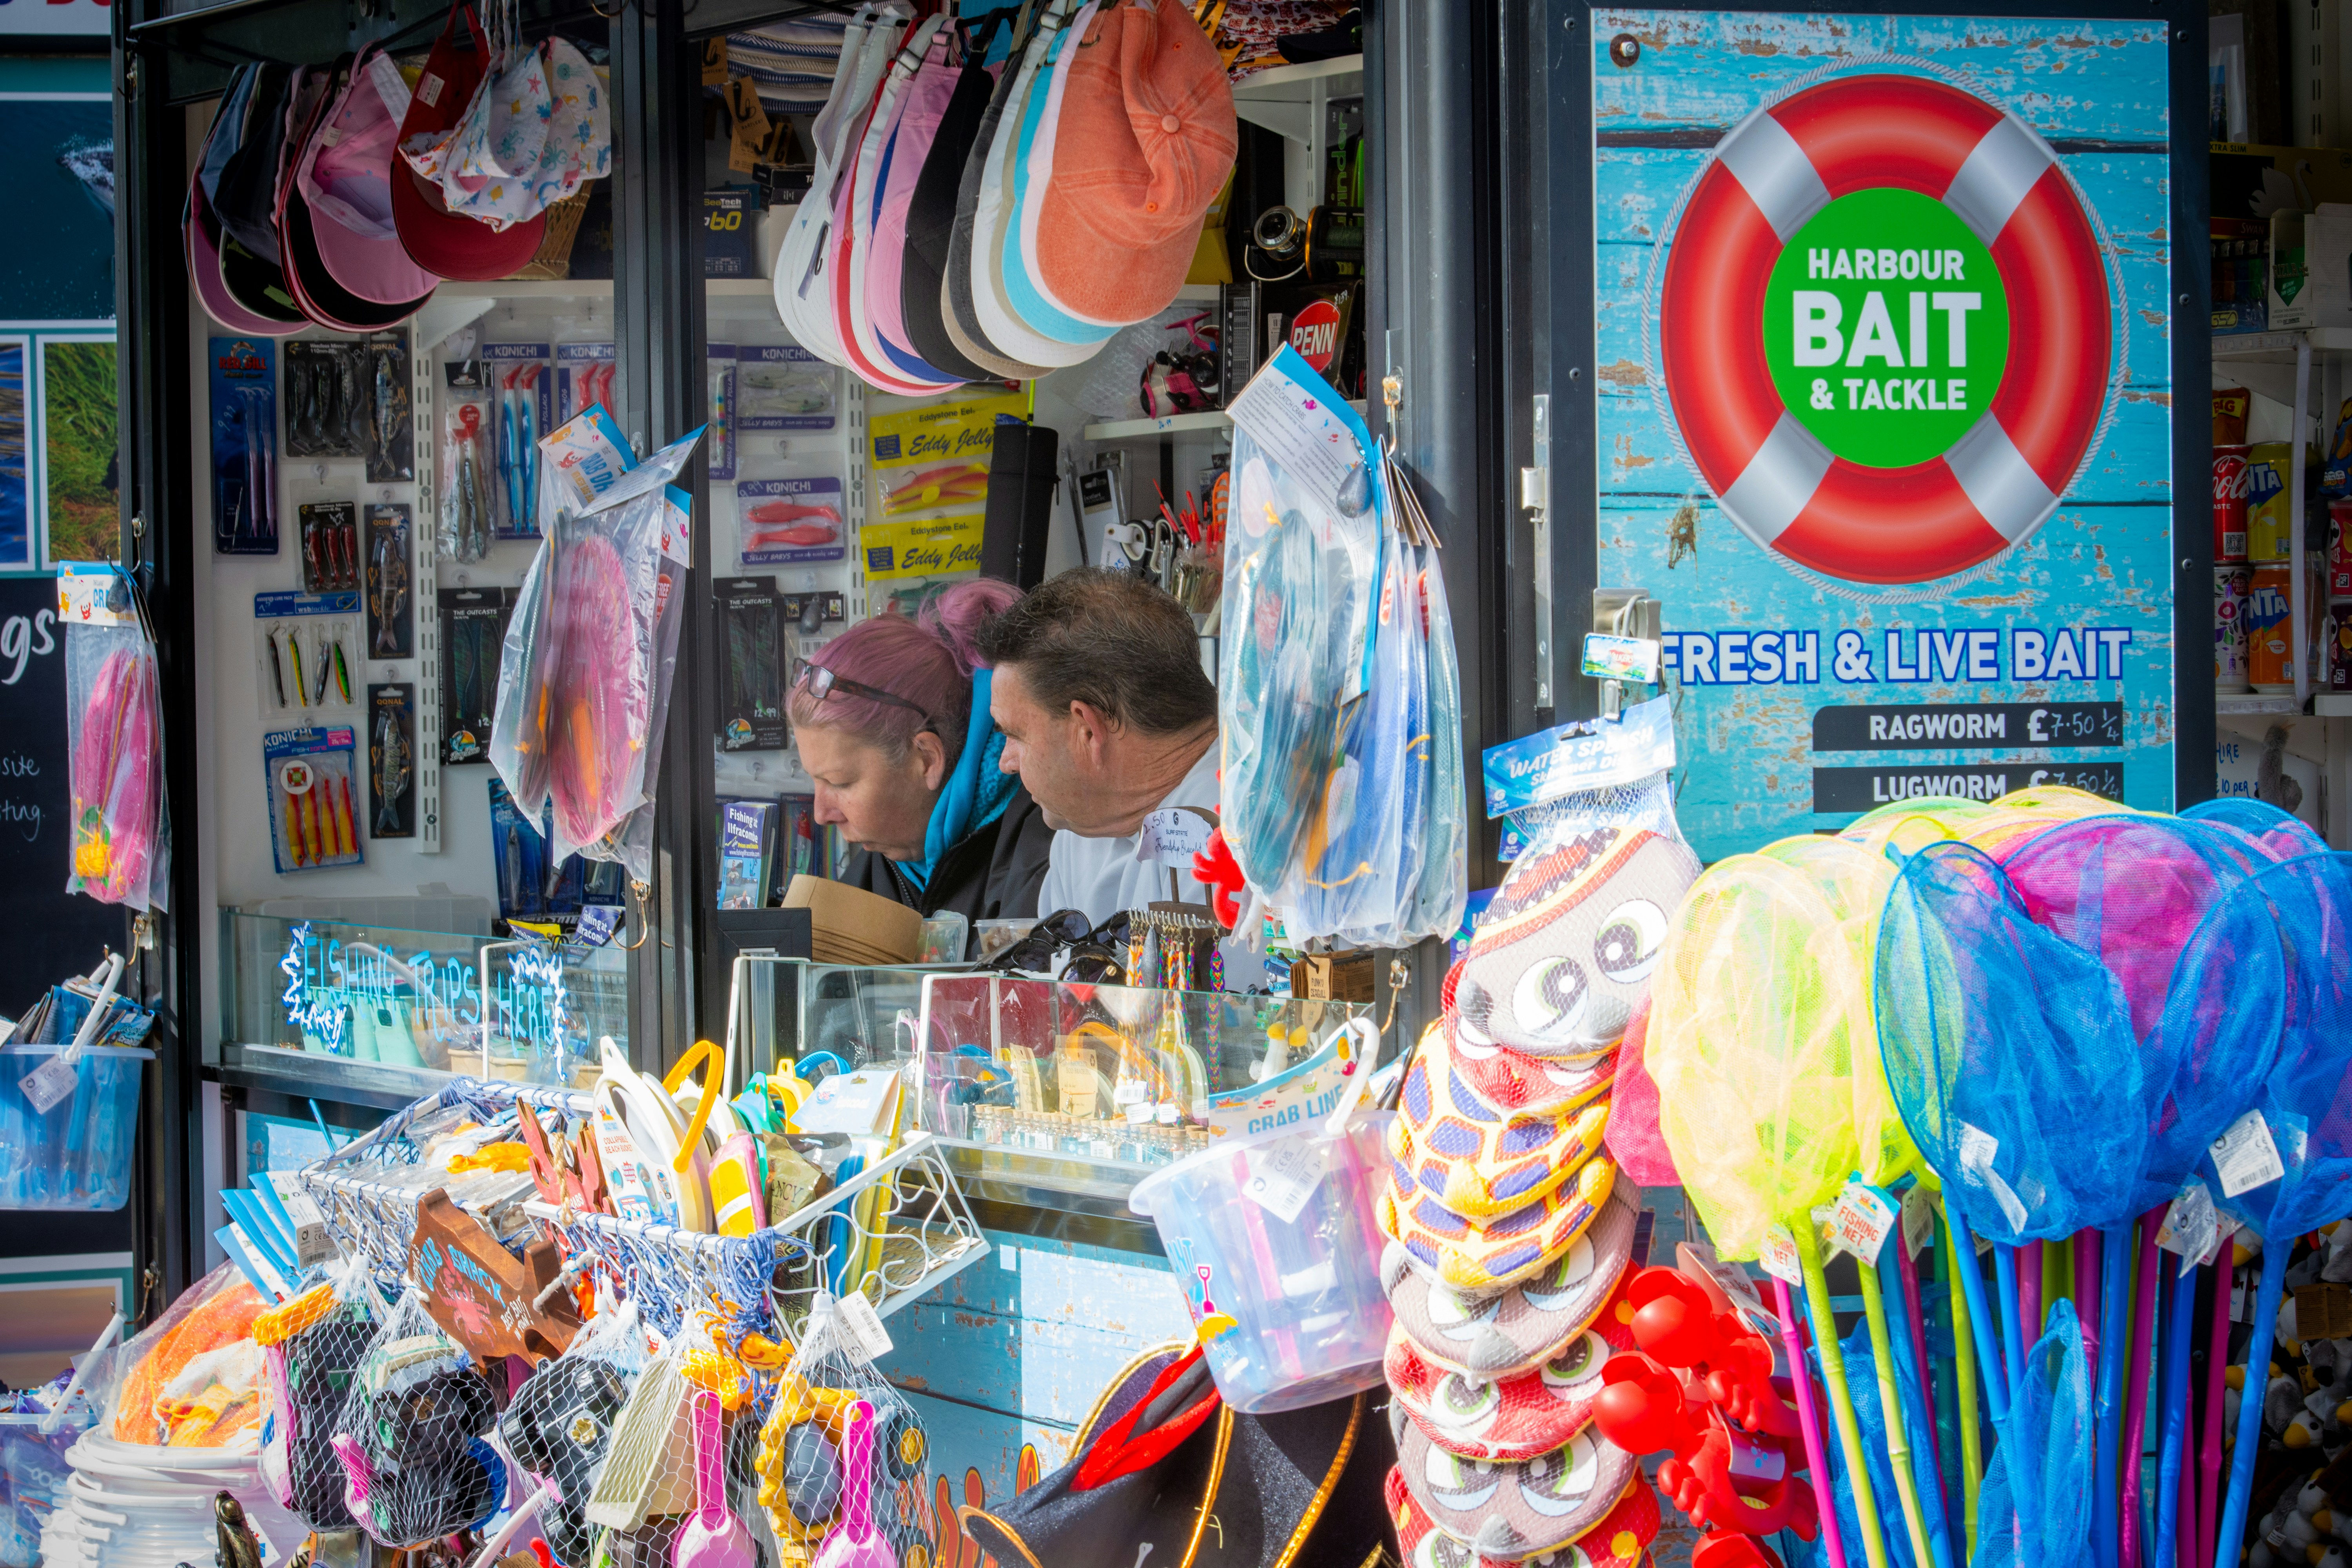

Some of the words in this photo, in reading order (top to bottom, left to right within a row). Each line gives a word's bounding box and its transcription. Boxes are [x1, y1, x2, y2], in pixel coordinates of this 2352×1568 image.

[2209, 143, 2228, 152] XTRA
[2230, 145, 2247, 153] SLIM
[1808, 248, 1965, 280] HARBOUR
[1294, 321, 1337, 356] PENN
[1793, 290, 1982, 368] BAIT
[495, 346, 537, 357] KONICHI
[762, 348, 806, 359] KONICHI
[219, 356, 241, 370] RED
[244, 356, 267, 370] GILL
[1810, 379, 1835, 410] &
[1843, 379, 1967, 410] TACKLE
[919, 409, 958, 422] Eddystone
[2213, 399, 2235, 414] BIG
[909, 434, 951, 456] Eddy
[955, 427, 994, 454] Jelly
[766, 481, 811, 493] KONICHI
[2247, 464, 2281, 492] NTA
[911, 525, 952, 535] Eddystone
[901, 547, 943, 569] Eddy
[2249, 588, 2288, 619] NTA
[1661, 631, 1819, 684] FRESH
[1833, 629, 1879, 683] &
[1886, 628, 2000, 682] LIVE
[2013, 627, 2132, 681] BAIT
[1869, 713, 2005, 740] RAGWORM
[1510, 744, 1574, 779] WATER
[1873, 775, 2006, 802] LUGWORM
[730, 808, 753, 829] Fishing
[753, 819, 758, 829] at
[728, 823, 758, 843] Ilfracombe
[1155, 837, 1180, 860] Friendship
[1181, 842, 1202, 855] Bracelet
[582, 909, 602, 931] Fishing
[1311, 977, 1324, 987] FUNKY
[305, 936, 394, 1018] FISHING
[408, 950, 482, 1043] TRIPS
[497, 971, 554, 1058] HERE
[1310, 988, 1326, 999] SEAGULL
[1248, 1104, 1300, 1135] CRAB
[1306, 1083, 1344, 1119] LINE
[603, 1135, 629, 1145] COLLAPSIBLE
[605, 1145, 621, 1154] BEACH
[621, 1144, 634, 1152] BUCKET
[568, 1193, 584, 1210] RABS
[771, 1178, 804, 1203] ANCY
[1838, 1205, 1880, 1242] FISHING
[1767, 1231, 1796, 1257] FISHING
[1842, 1226, 1866, 1247] NET
[1774, 1248, 1789, 1267] NET
[419, 1236, 443, 1292] CRAB
[447, 1243, 506, 1309] SHACK
[500, 1306, 514, 1333] BEST
[510, 1294, 525, 1319] BAIT
[514, 1327, 522, 1341] IN
